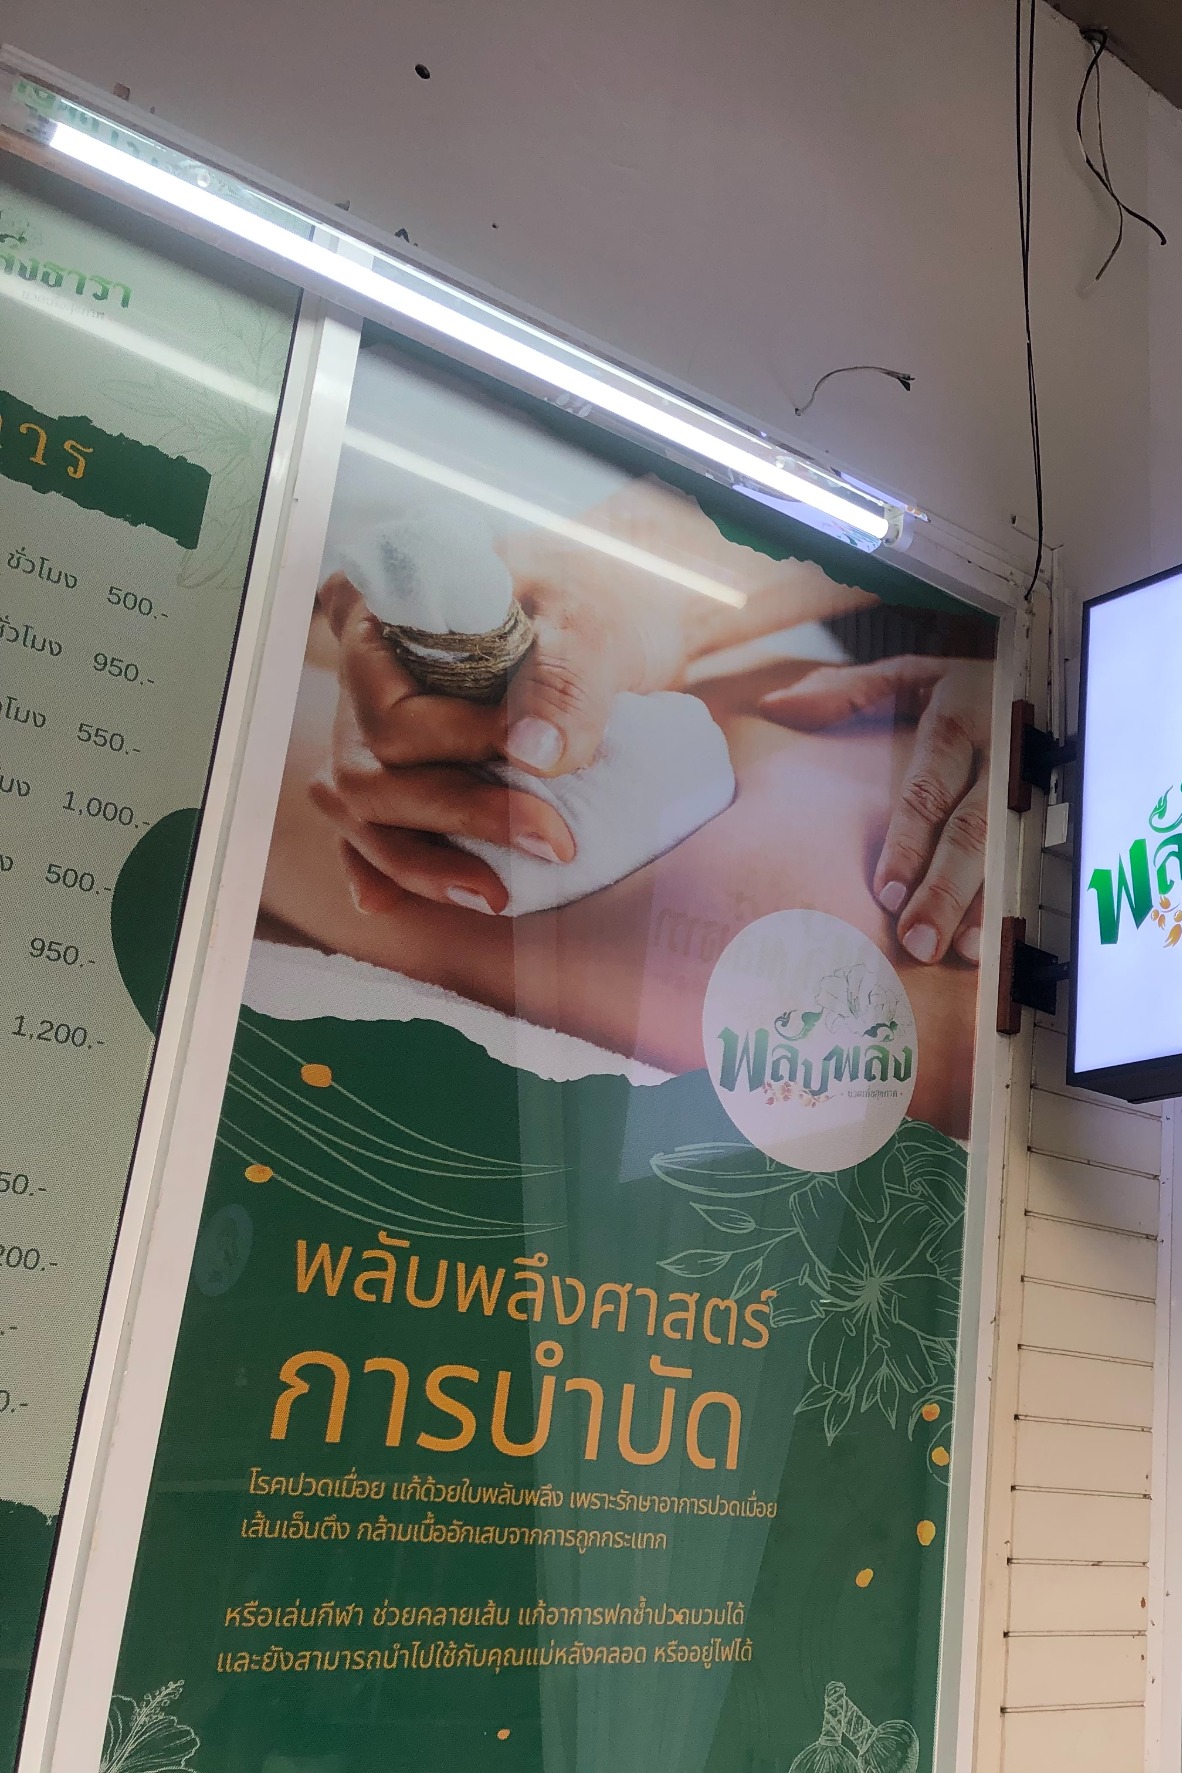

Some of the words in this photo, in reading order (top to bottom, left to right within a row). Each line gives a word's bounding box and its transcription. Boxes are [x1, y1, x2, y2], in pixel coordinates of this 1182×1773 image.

[0, 412, 94, 479] าร
[6, 546, 78, 590] ชั่วโมง
[107, 586, 168, 619] 500.-
[93, 652, 154, 685] 950.-
[0, 696, 46, 728] โมง
[77, 723, 140, 755] 550.-
[62, 791, 150, 829] 1,000.-
[45, 864, 111, 895] 500.-
[29, 937, 95, 967] 950.-
[12, 1015, 104, 1050] 1,200.-
[0, 1245, 58, 1271] 00.-
[295, 1230, 777, 1350] พลับพลึงศาสตร์
[269, 1340, 743, 1470] การบำบัด
[248, 1467, 386, 1501] โรคปวดเมื่อย
[391, 1474, 564, 1509] แก้ด้วยใบพลับพลึง
[569, 1488, 779, 1520] เพราะรักษาอาการปวดเมื่อย
[240, 1509, 351, 1541] เส้นเอ็นตึง
[355, 1511, 667, 1555] กล้ามเนื้ออักเสบจากการถูกกระแทก
[224, 1599, 364, 1629] หรือเล่นกีฬา
[372, 1598, 510, 1628] ช่วยคลายเส้น
[517, 1596, 746, 1627] แก้อาการฟกช้ำปวดบวมได้
[215, 1638, 647, 1676] และยังสามารถนำไปใช้กับคุณแม่หลังคลอด
[652, 1637, 754, 1670] หรืออยู่ไฟได้
